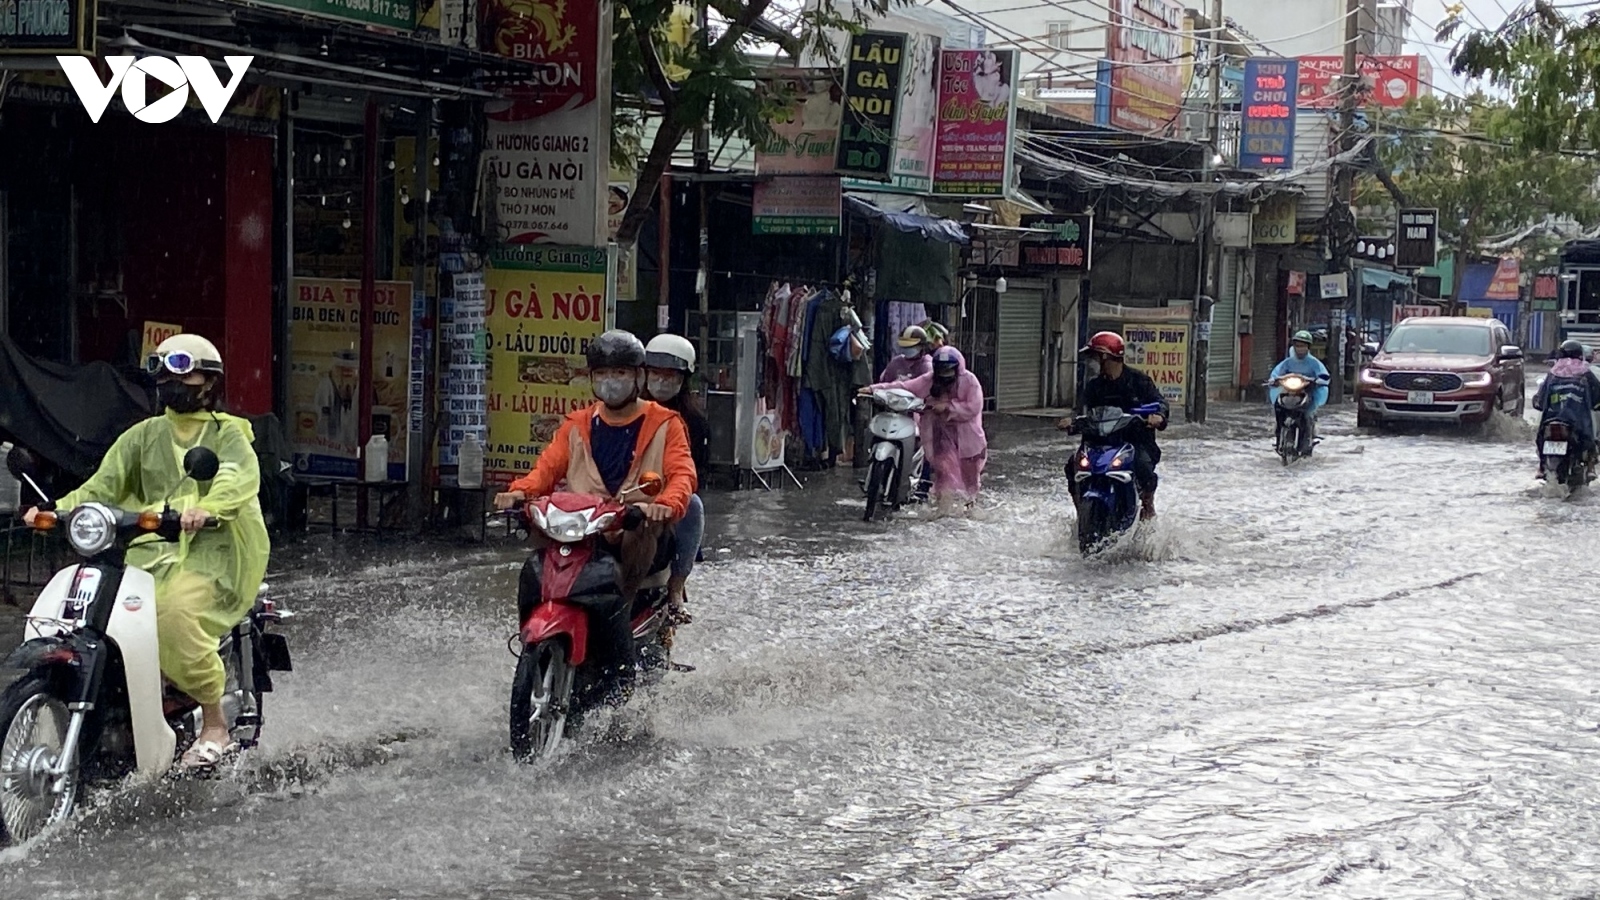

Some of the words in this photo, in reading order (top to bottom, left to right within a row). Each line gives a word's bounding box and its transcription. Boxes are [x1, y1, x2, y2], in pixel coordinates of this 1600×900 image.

[513, 43, 545, 59] BIA
[852, 39, 900, 65] LẨU
[857, 68, 889, 89] GÀ
[849, 94, 892, 115] NÒI
[1247, 121, 1287, 135] HOA
[542, 135, 580, 152] GIANG
[582, 136, 589, 152] 2
[846, 147, 881, 168] BÒ
[517, 158, 542, 180] GÀ
[549, 158, 583, 181] NÒI
[547, 248, 589, 269] Giang
[595, 250, 603, 265] 2
[299, 285, 337, 304] BIA
[343, 286, 395, 306] TƠI
[504, 282, 544, 319] GÀ
[552, 285, 602, 322] NÒI
[292, 306, 315, 321] BIA
[505, 322, 536, 352] LẨU
[512, 385, 539, 413] LẨU
